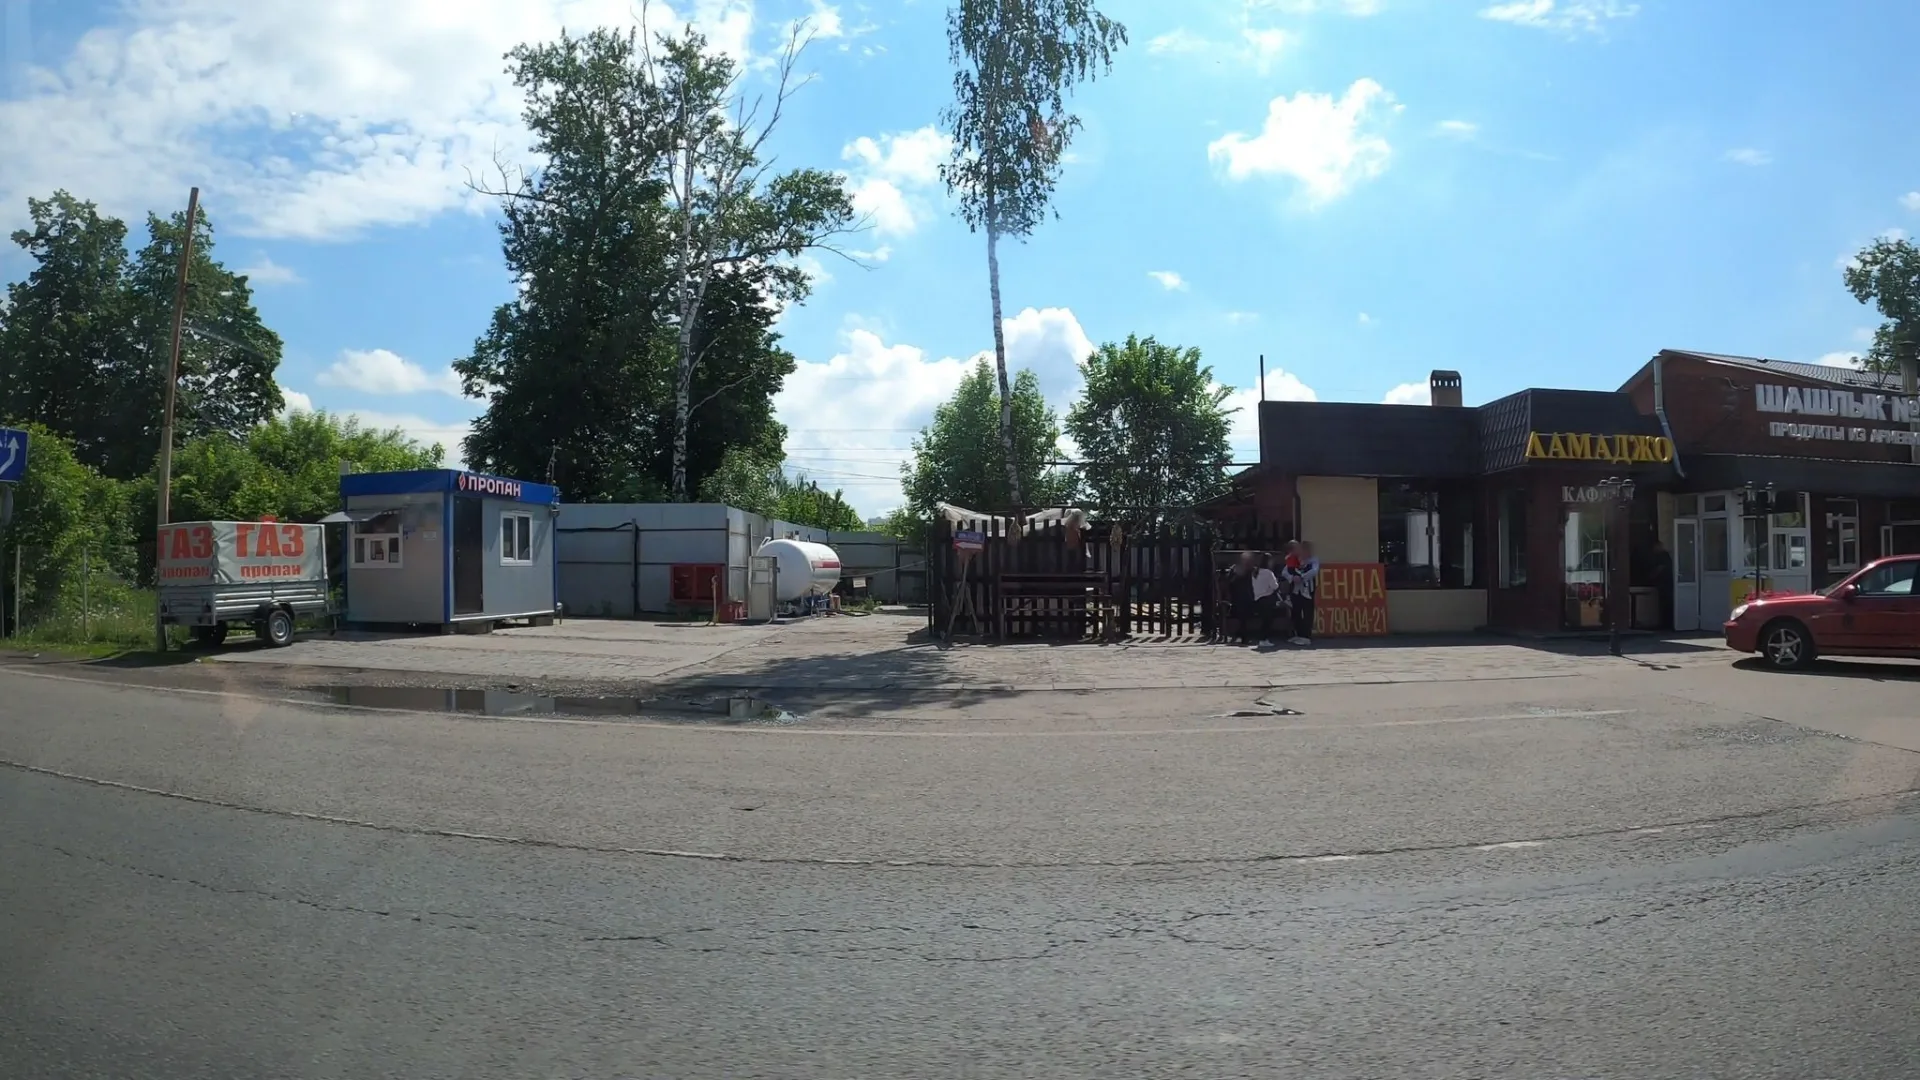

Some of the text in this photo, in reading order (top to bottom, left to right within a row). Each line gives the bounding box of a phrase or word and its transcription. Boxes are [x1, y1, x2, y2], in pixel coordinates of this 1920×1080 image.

[1755, 384, 1888, 421] ШАШЛЫК
[1769, 421, 1845, 441] ПРОДУКТЫ
[1848, 427, 1867, 443] ИЗ
[468, 475, 521, 497] ПРОПАН
[158, 526, 213, 560] ГАЗ
[235, 524, 305, 558] ГАЗ
[240, 564, 301, 579] пропан
[1326, 606, 1387, 634] 790-04-21
